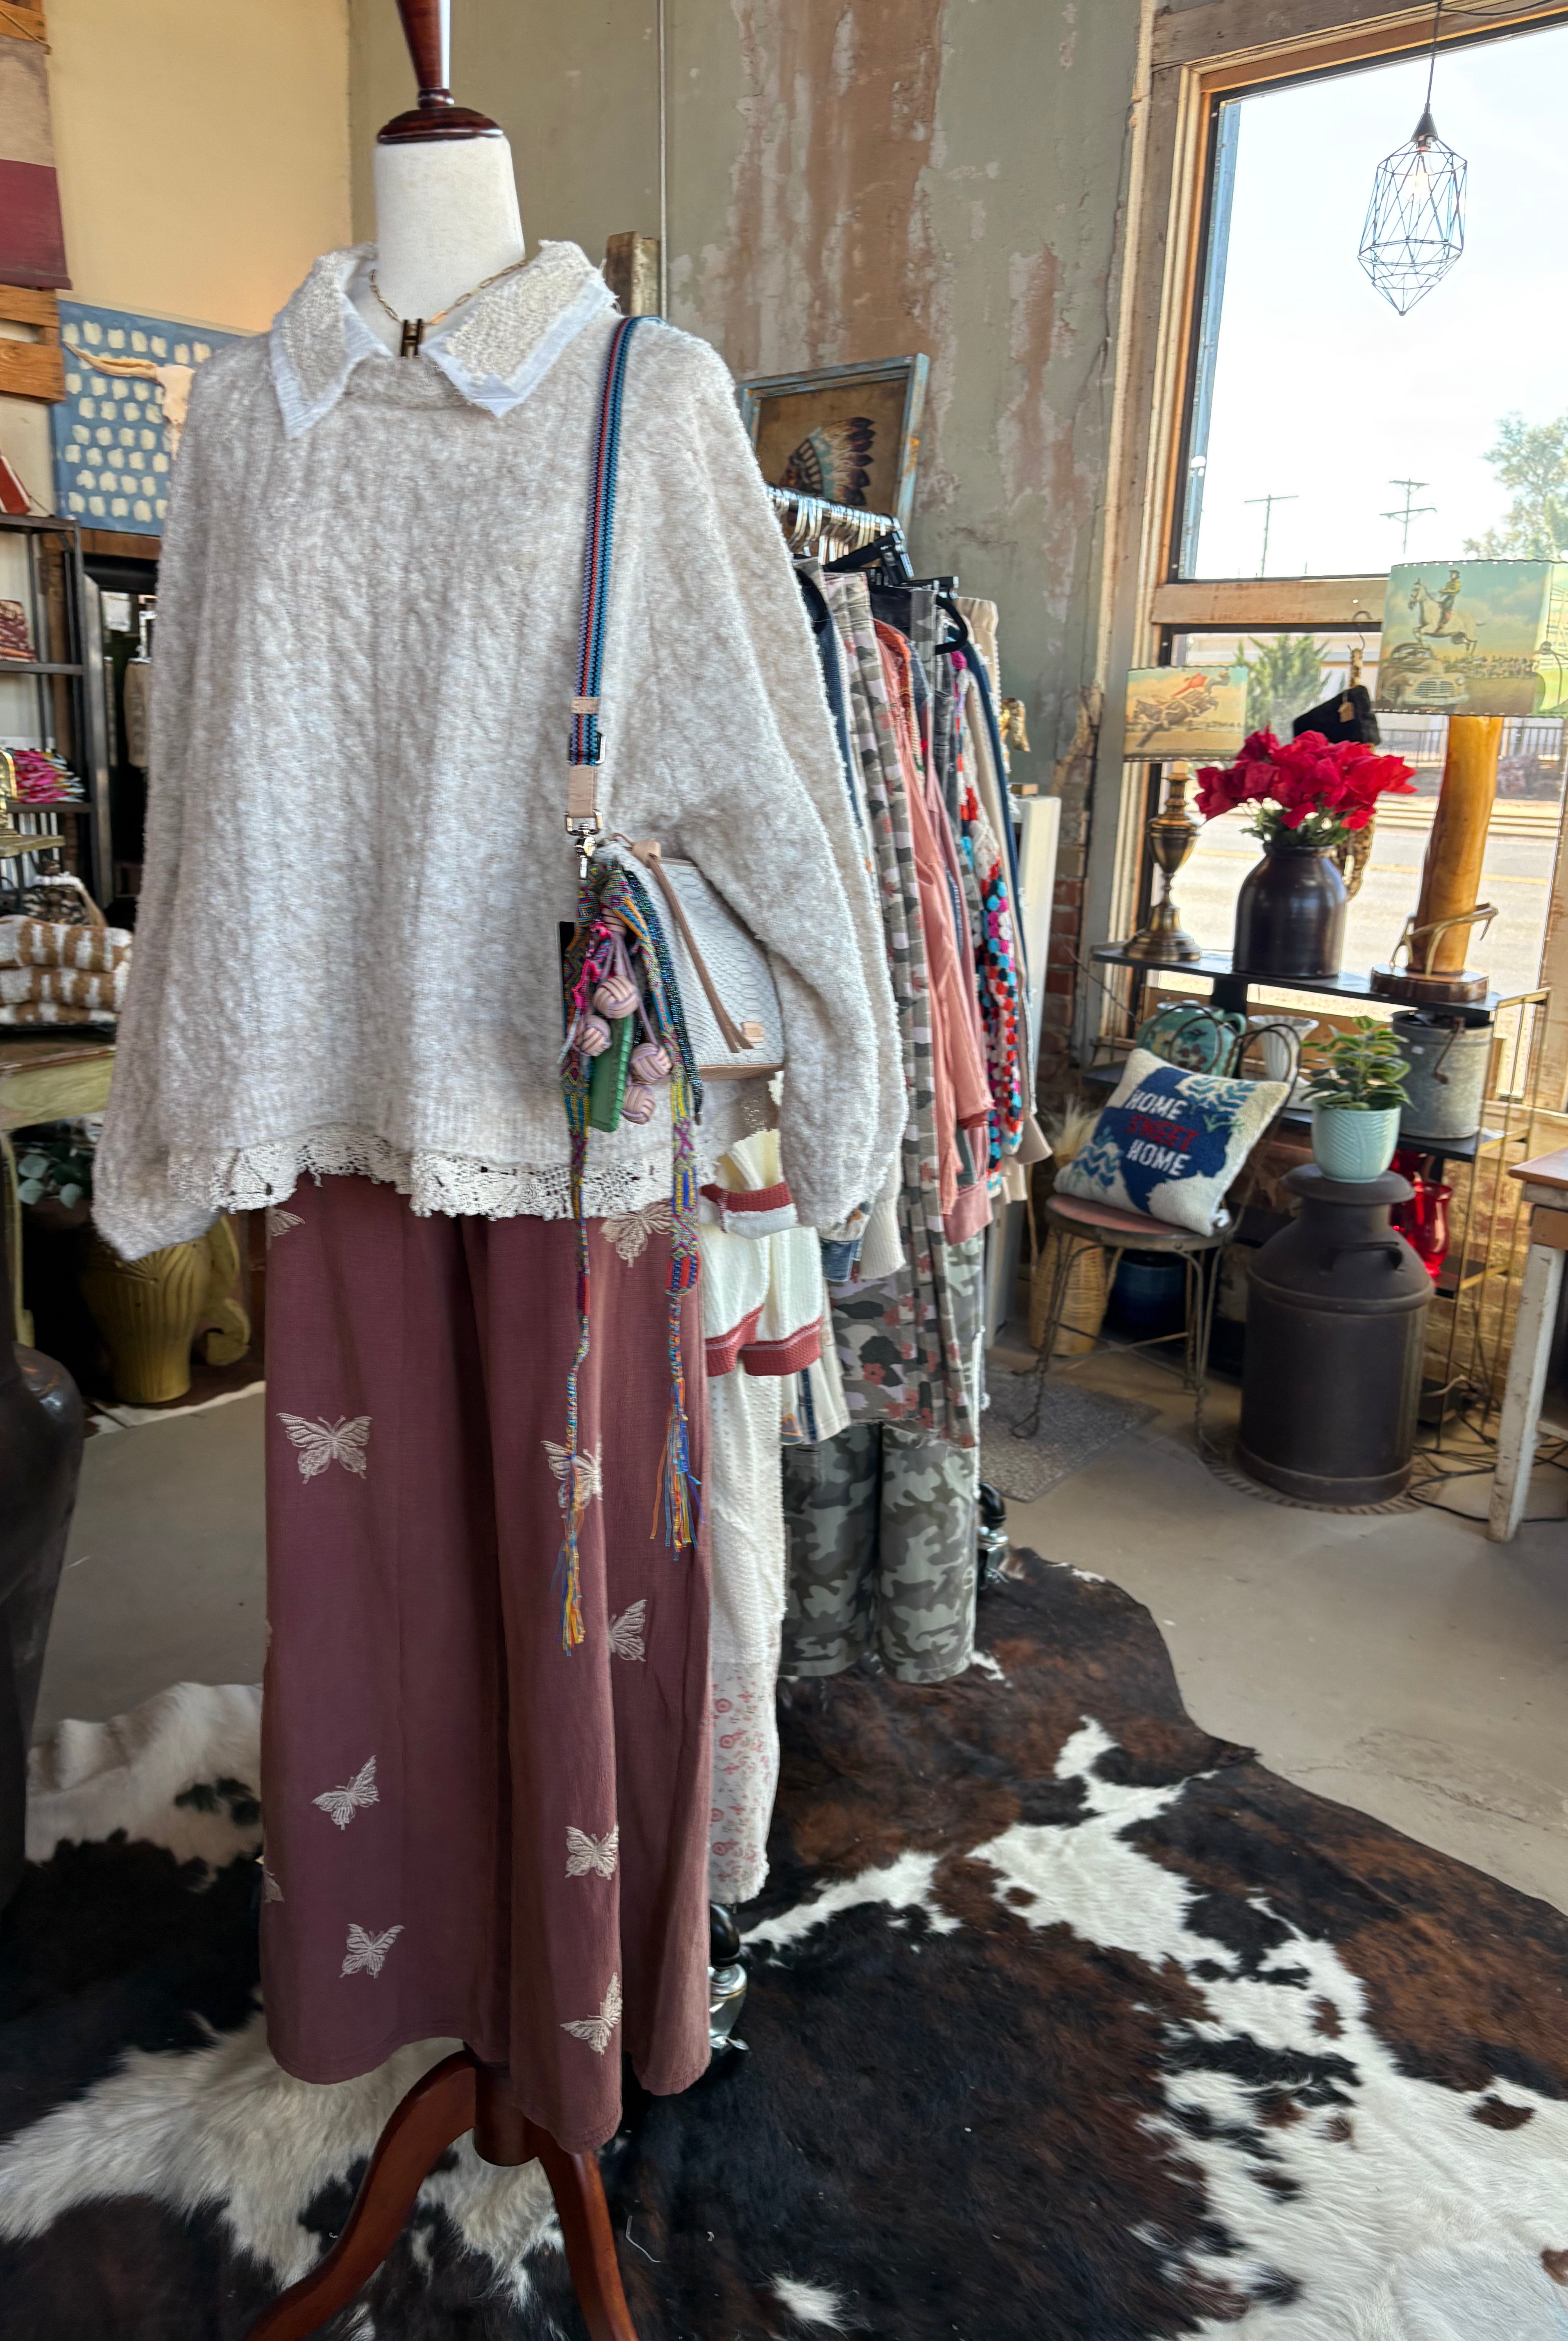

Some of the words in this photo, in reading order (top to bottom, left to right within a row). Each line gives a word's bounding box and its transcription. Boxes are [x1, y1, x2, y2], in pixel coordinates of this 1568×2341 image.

[1125, 1089, 1188, 1120] HOME
[1127, 1114, 1198, 1152] SWEET
[1127, 1139, 1191, 1176] HOME
